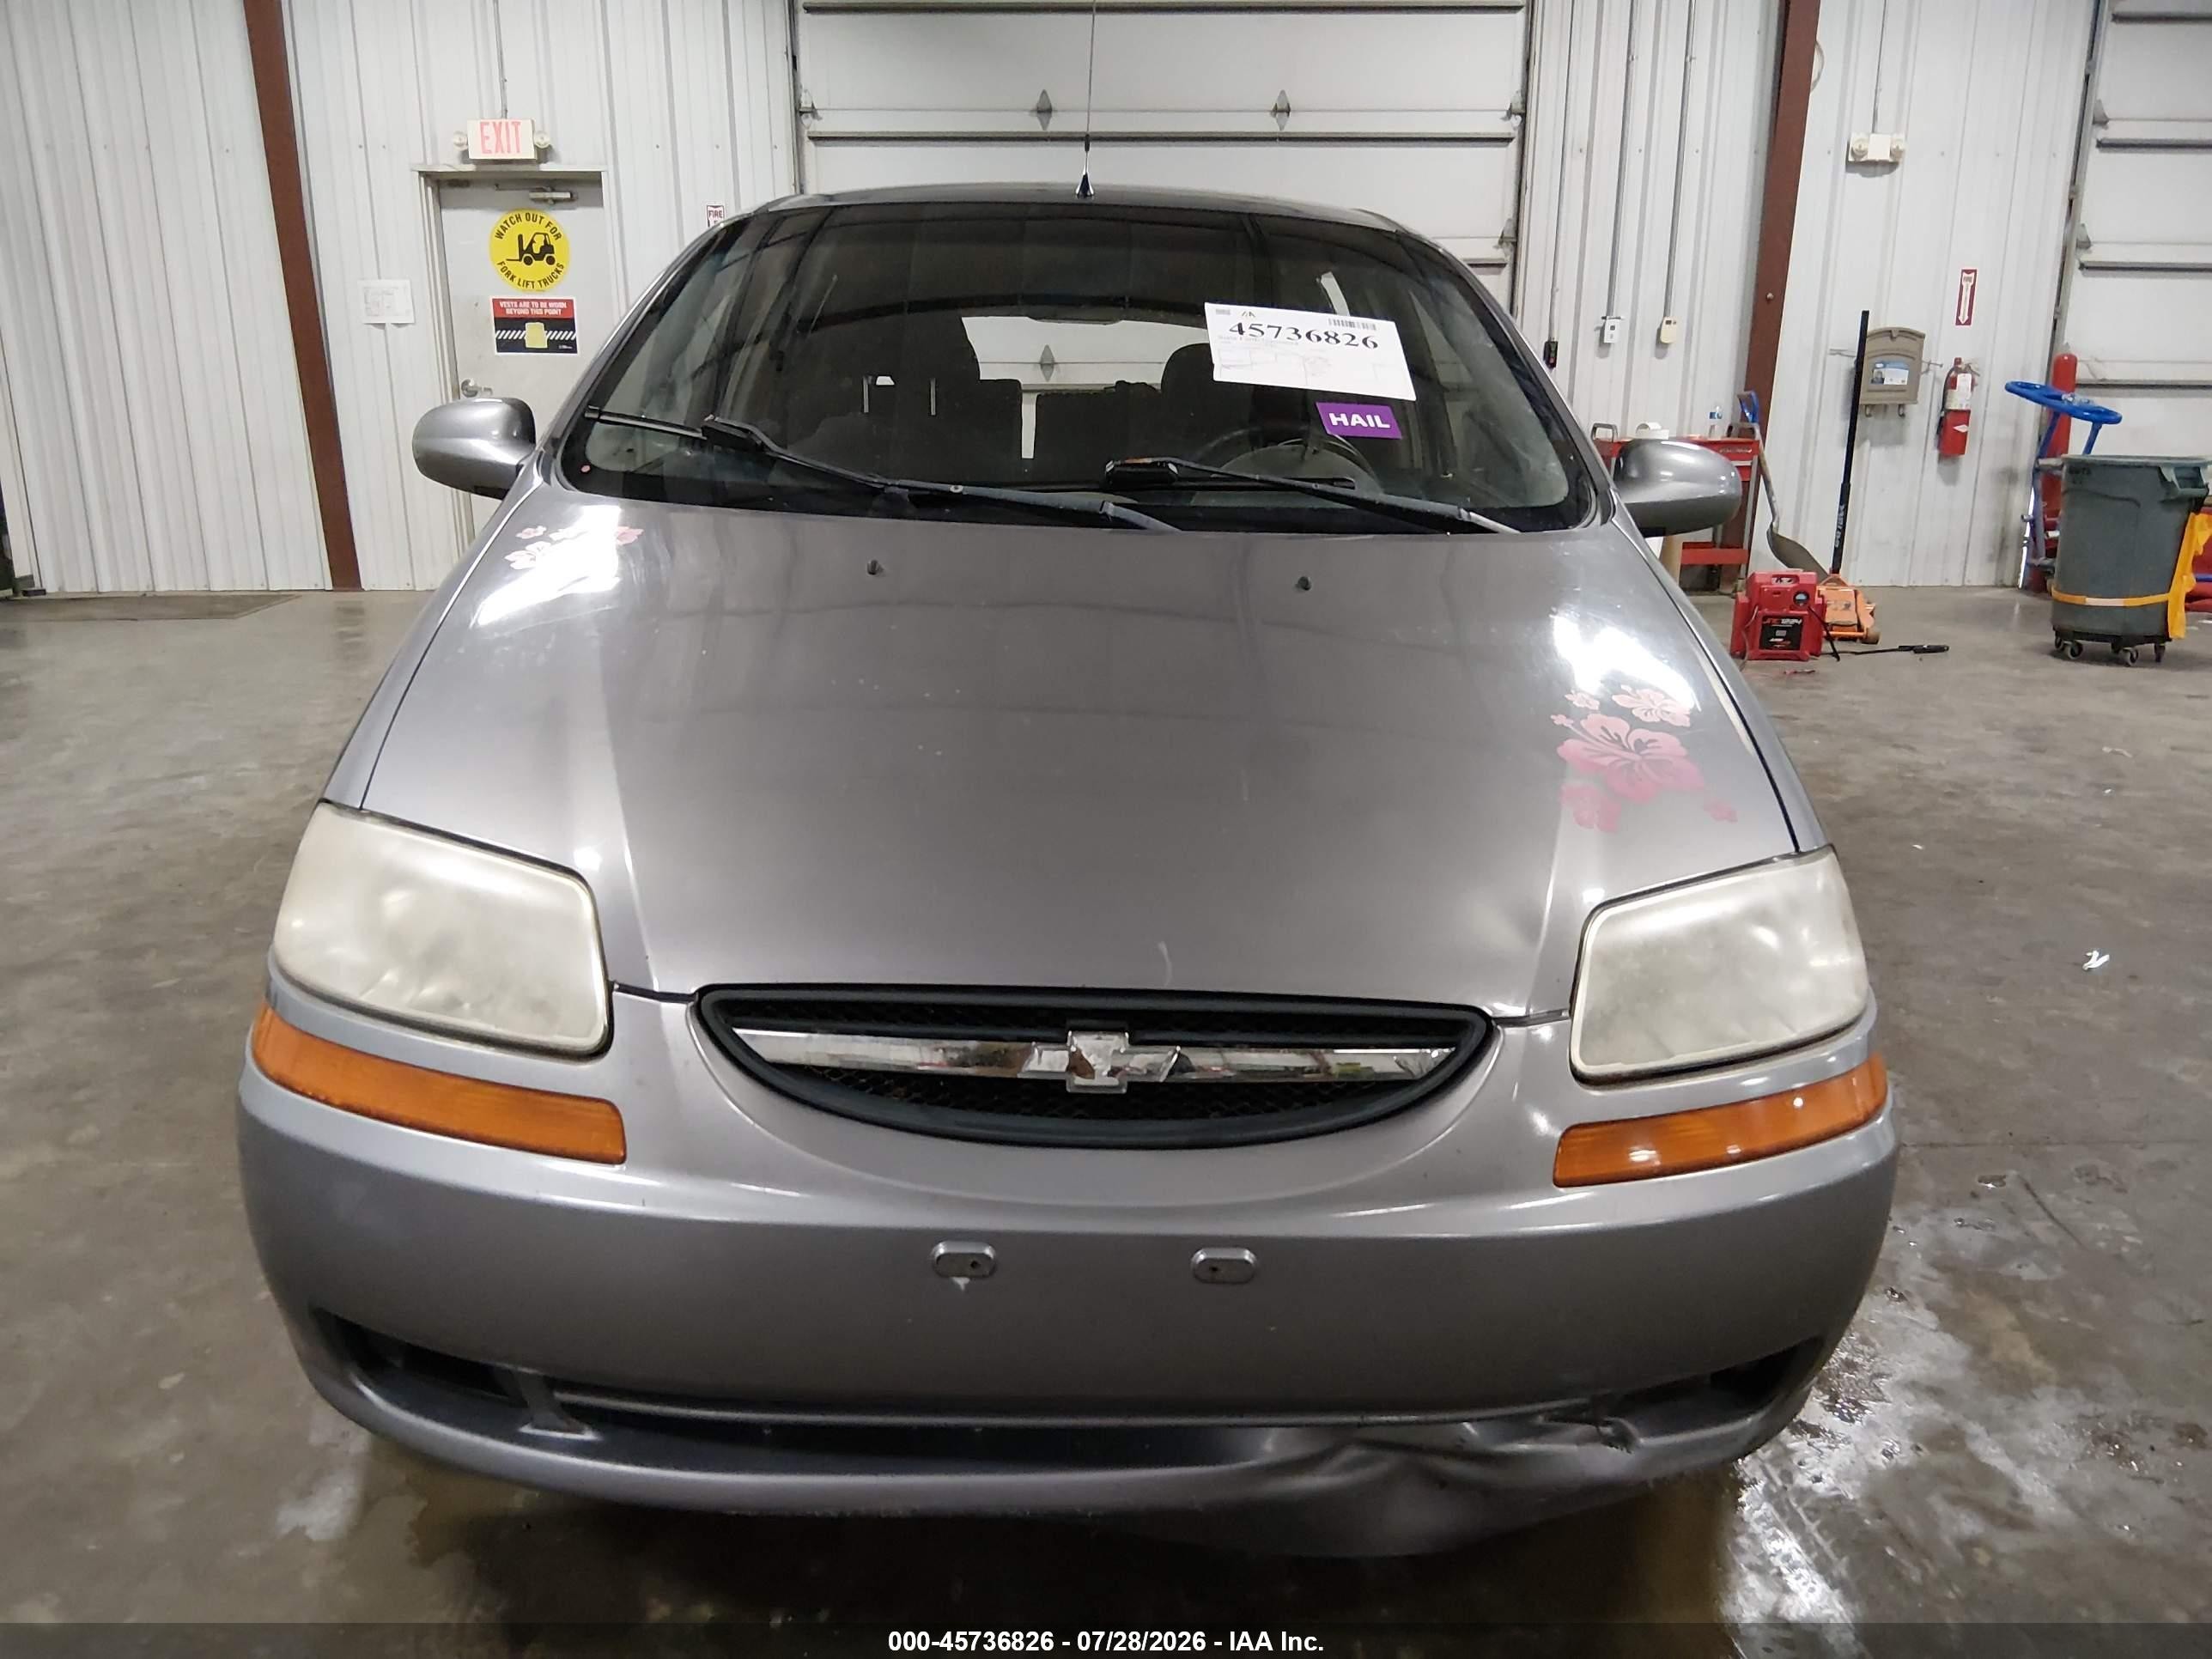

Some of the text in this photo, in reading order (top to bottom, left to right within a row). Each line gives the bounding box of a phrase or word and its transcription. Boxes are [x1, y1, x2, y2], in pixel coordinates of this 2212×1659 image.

[480, 121, 520, 154] EXIT
[495, 212, 562, 240] WATCH OUT FOR
[708, 210, 722, 218] FIRE
[496, 260, 564, 289] FORK LIFT TRUCKS
[1229, 322, 1378, 349] 45736826
[1328, 413, 1390, 428] HAIL
